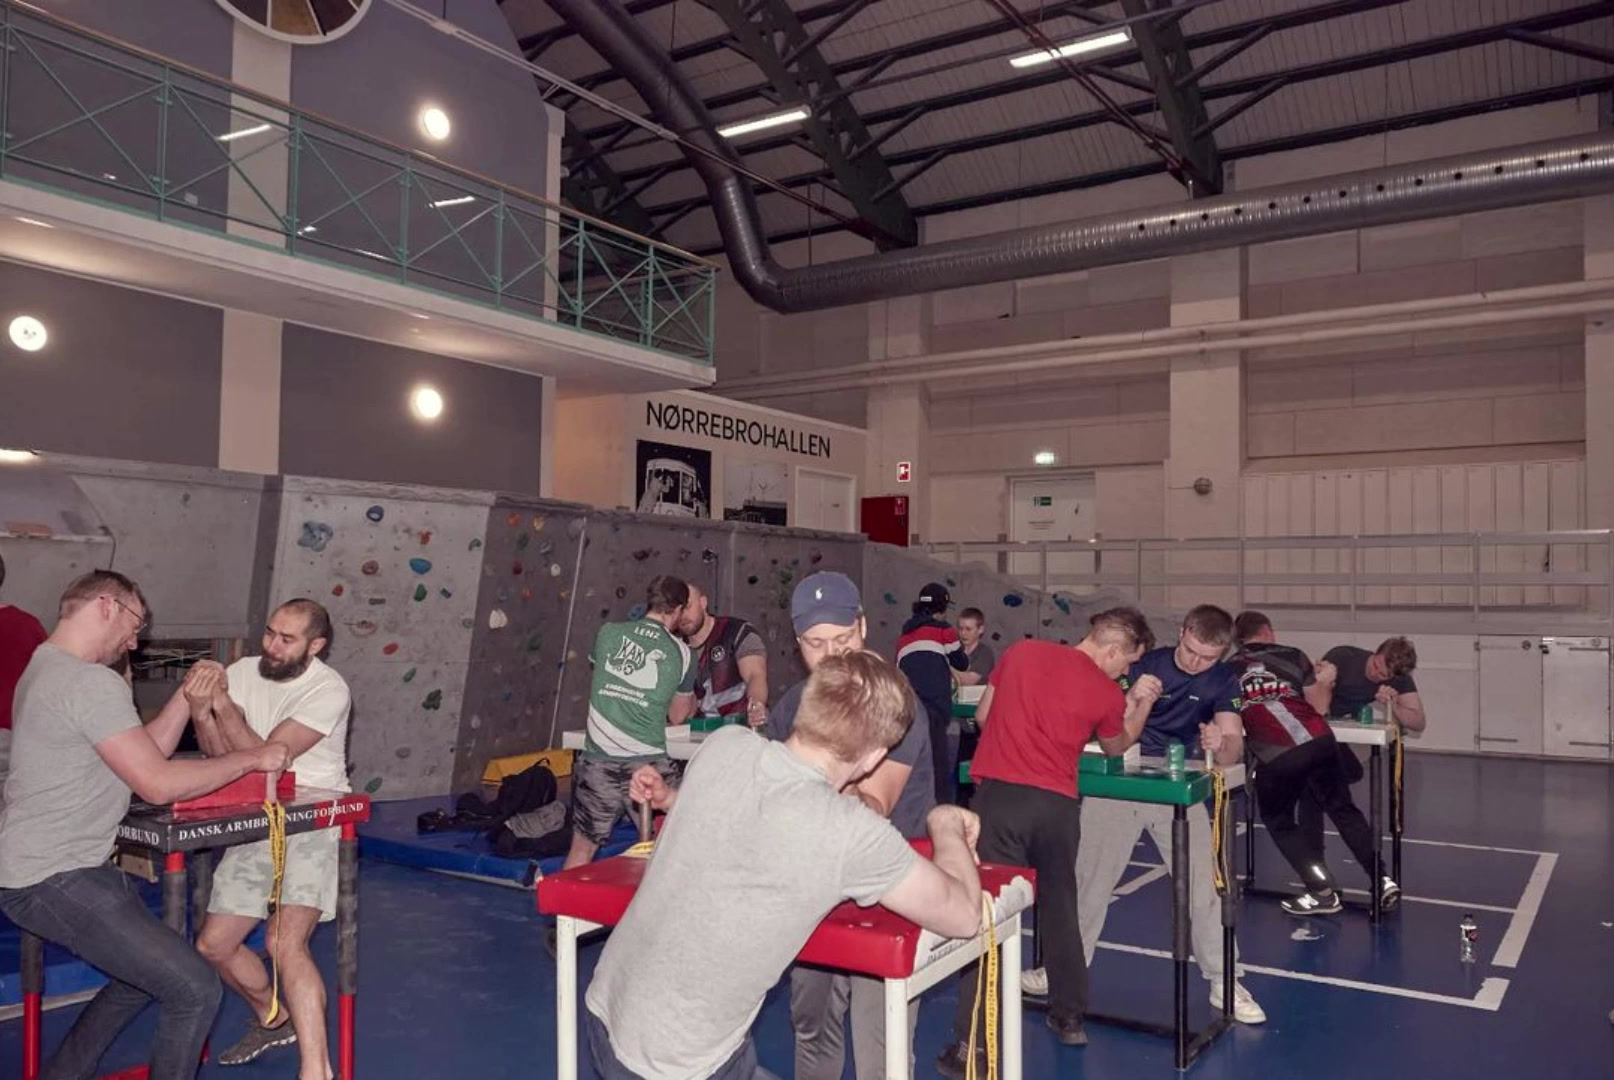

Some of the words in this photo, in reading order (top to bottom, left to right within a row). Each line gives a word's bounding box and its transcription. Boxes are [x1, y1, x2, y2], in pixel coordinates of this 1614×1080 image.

[646, 401, 831, 458] NØRREBROHALLEN
[179, 823, 222, 841] DANSK
[225, 802, 364, 832] ARMBRNINGFORBUND
